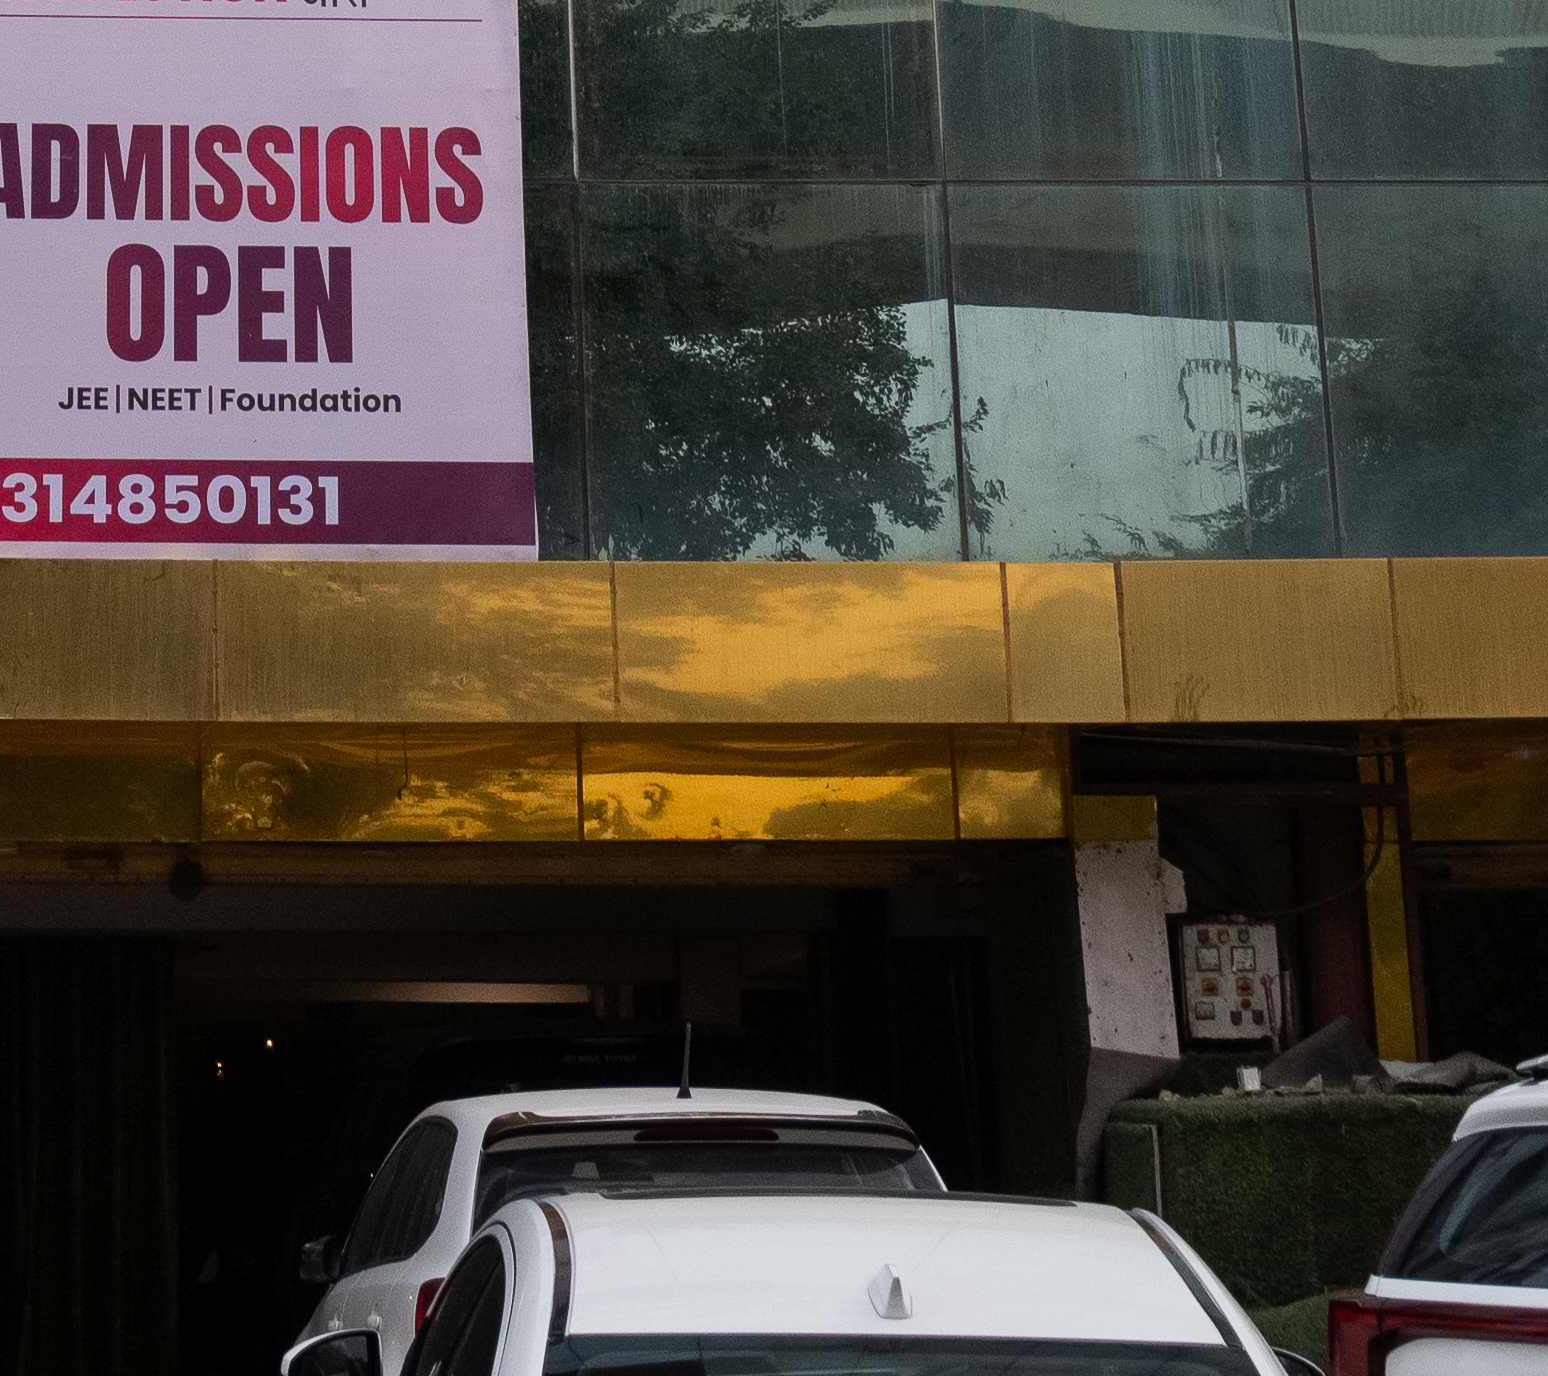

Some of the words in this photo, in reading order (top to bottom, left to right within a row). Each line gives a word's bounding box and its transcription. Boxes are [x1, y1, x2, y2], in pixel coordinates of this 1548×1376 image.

[103, 243, 354, 365] OPEN
[58, 386, 110, 413] JEE
[127, 387, 202, 414] NEET
[219, 386, 402, 415] Foundation
